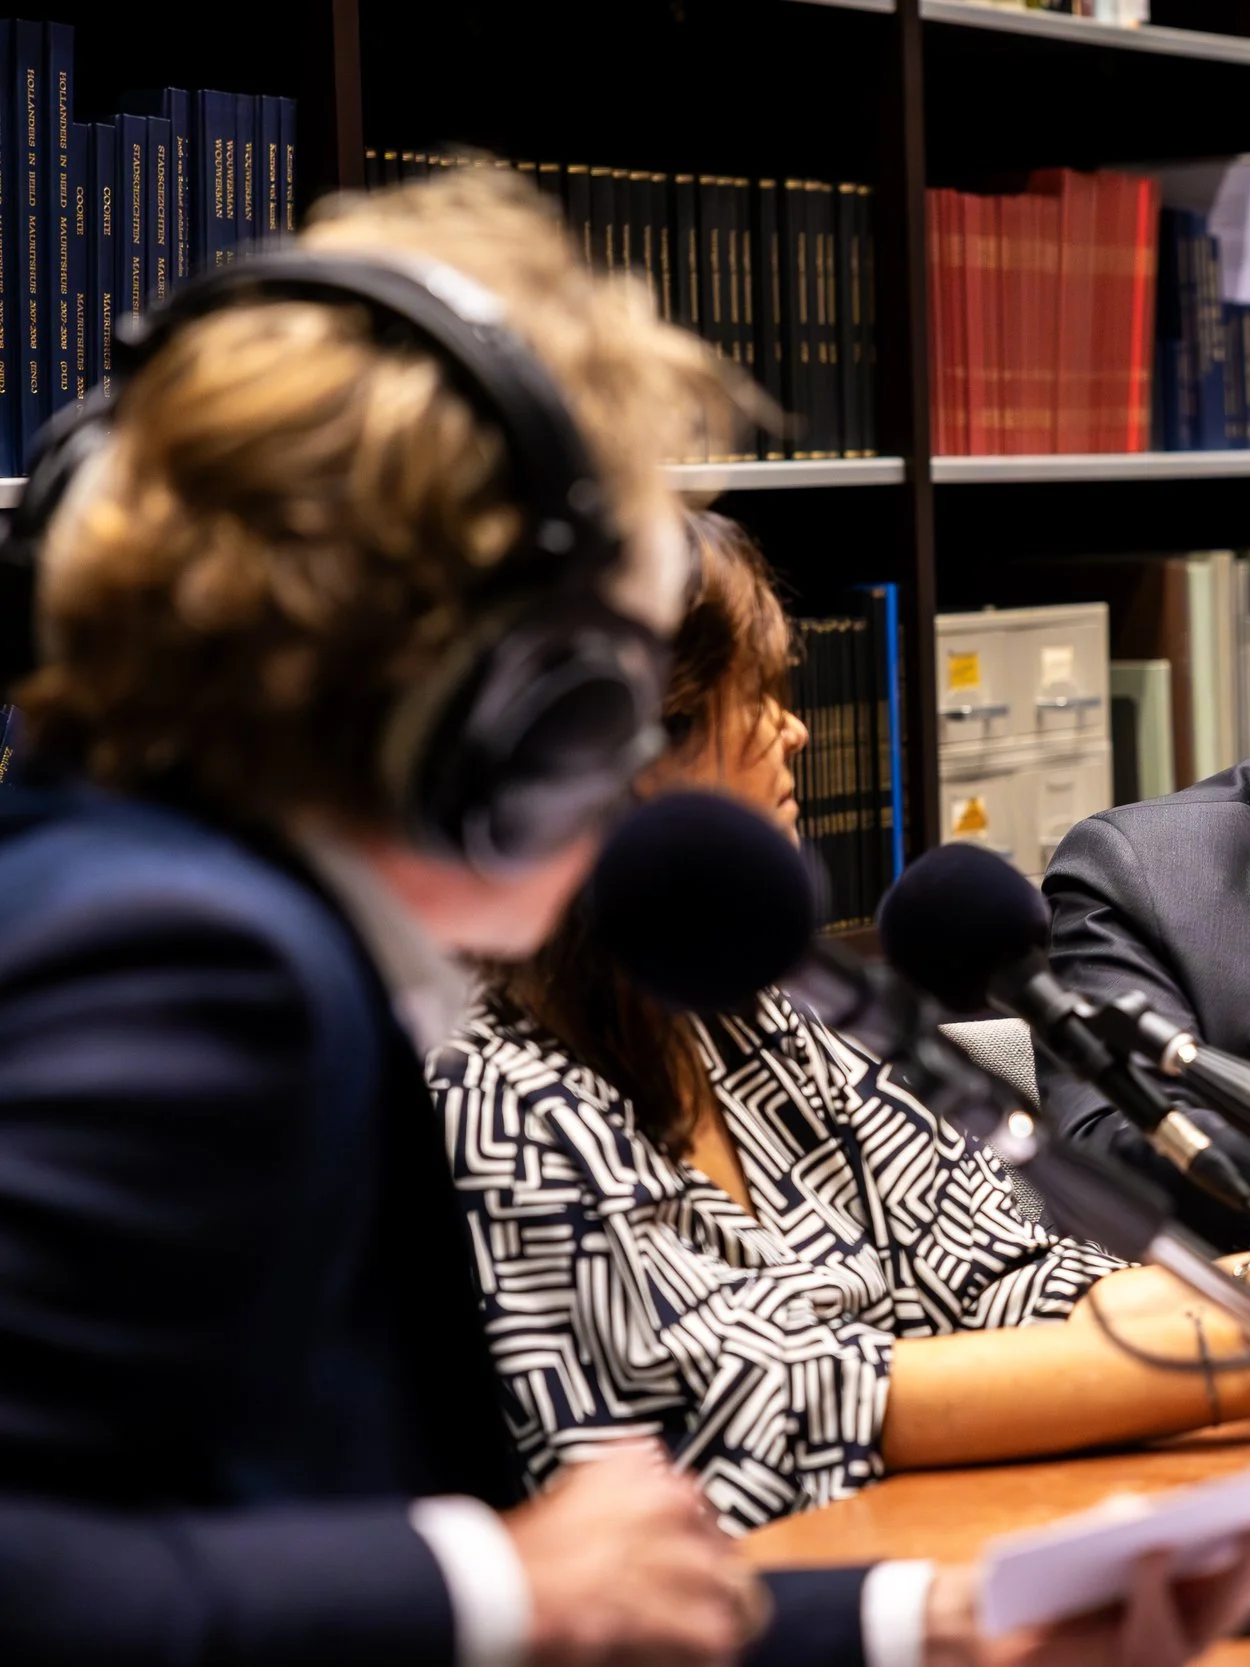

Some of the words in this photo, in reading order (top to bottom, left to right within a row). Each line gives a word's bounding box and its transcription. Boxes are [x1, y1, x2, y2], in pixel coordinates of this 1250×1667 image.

[26, 68, 36, 147] HOLLANDERS
[59, 71, 68, 149] HOLLANDERS
[28, 152, 37, 166] IN
[28, 171, 37, 207] BEELD
[59, 154, 68, 168] IN
[59, 172, 68, 208] BEELD
[132, 143, 142, 245] STADSGEZICHTEN
[157, 144, 166, 246] STADSGEZICHTEN
[214, 138, 224, 219] WOUWERMAN
[225, 139, 235, 220] WOUWERMAN
[244, 142, 253, 221] WOUWERMAN
[76, 186, 85, 236] COORTE
[103, 186, 112, 236] COORTE
[28, 214, 37, 294] MAURITSHUIS
[59, 215, 68, 295] MAURITSHUIS
[29, 299, 38, 350] 2007-2008
[60, 300, 69, 352] 2007-2008
[76, 292, 86, 372] MAURITSHUIS
[103, 292, 112, 371] MAURITSHUIS
